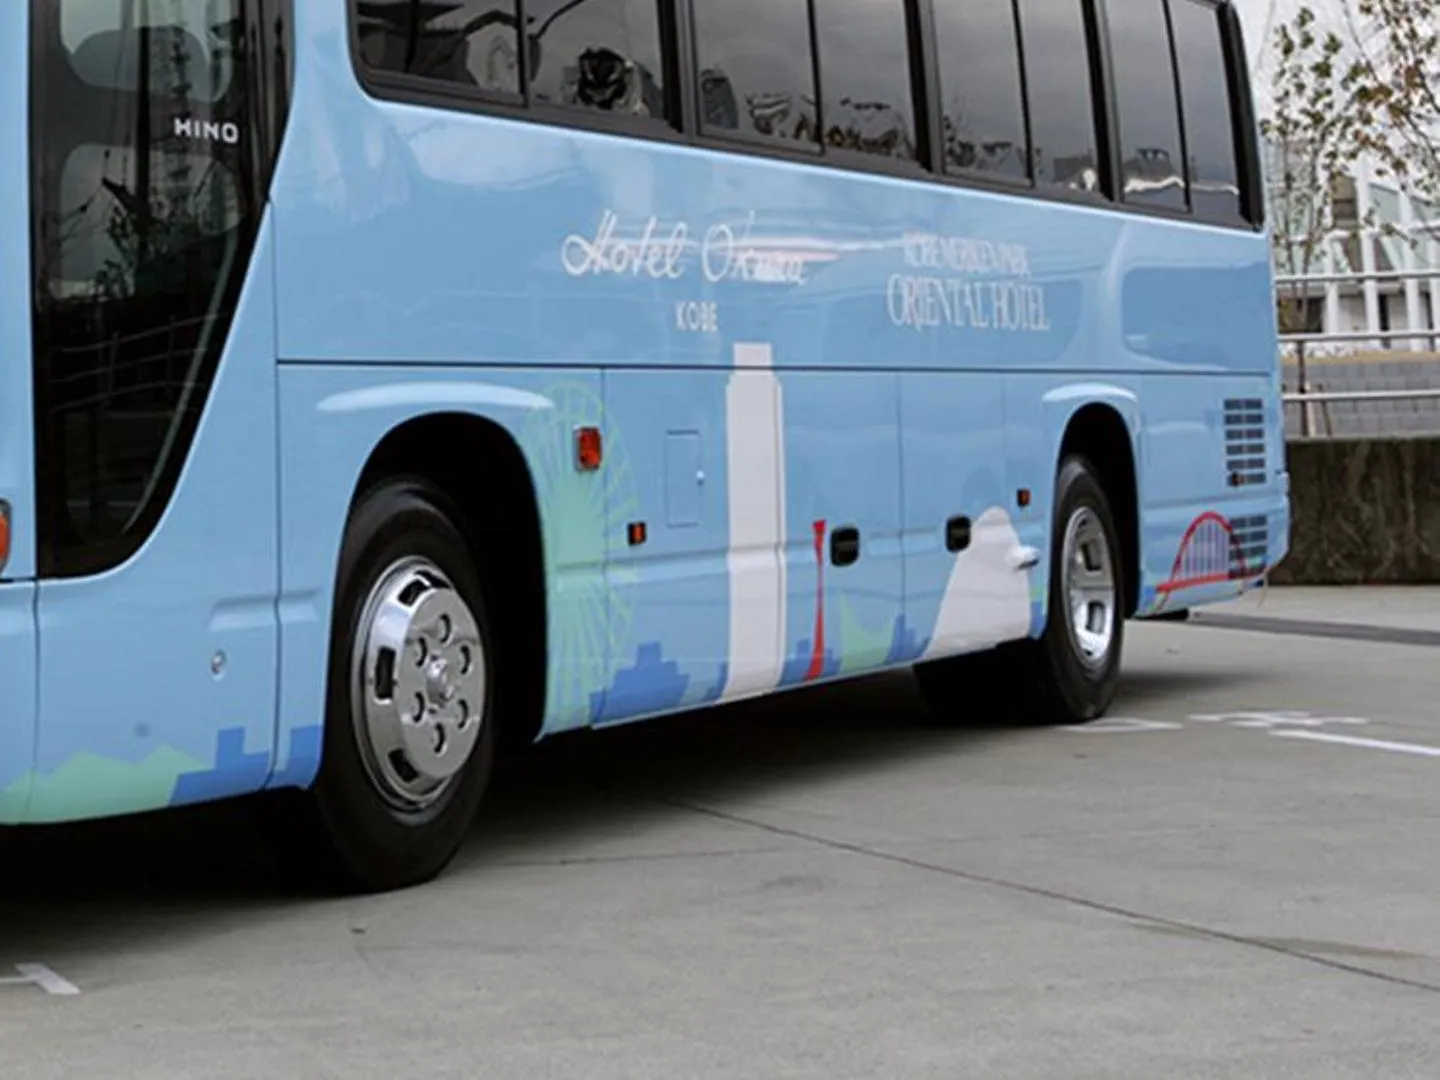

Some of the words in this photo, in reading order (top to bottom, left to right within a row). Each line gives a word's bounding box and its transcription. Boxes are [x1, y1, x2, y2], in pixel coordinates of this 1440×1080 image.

[173, 117, 239, 144] HINO
[559, 209, 689, 280] Hotel
[675, 301, 719, 332] KOBE
[886, 273, 990, 333] ORIENTAL
[990, 280, 1052, 332] HOTEL
